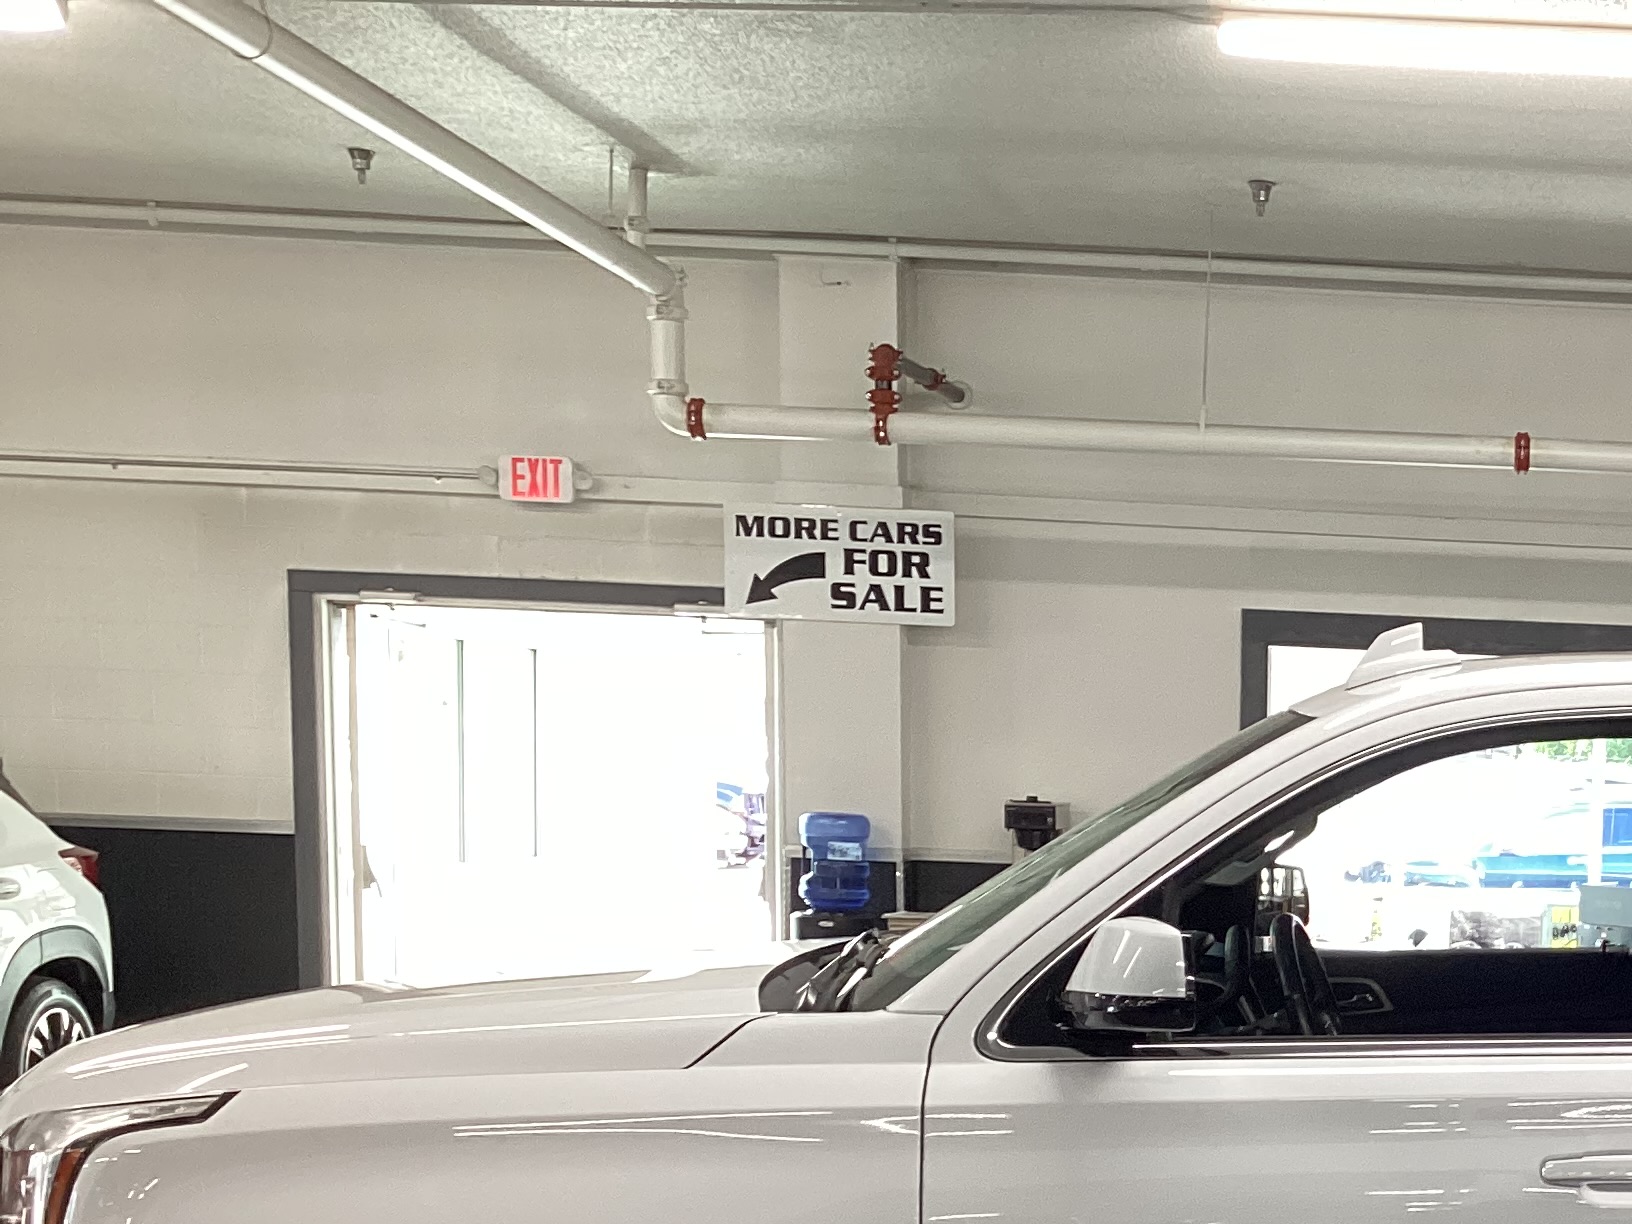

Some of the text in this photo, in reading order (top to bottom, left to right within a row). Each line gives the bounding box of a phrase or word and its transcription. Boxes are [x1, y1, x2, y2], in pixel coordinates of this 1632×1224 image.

[511, 456, 563, 499] EXIT
[735, 513, 943, 547] MORE CARS
[842, 547, 931, 580] FOR
[830, 581, 945, 615] SALE
